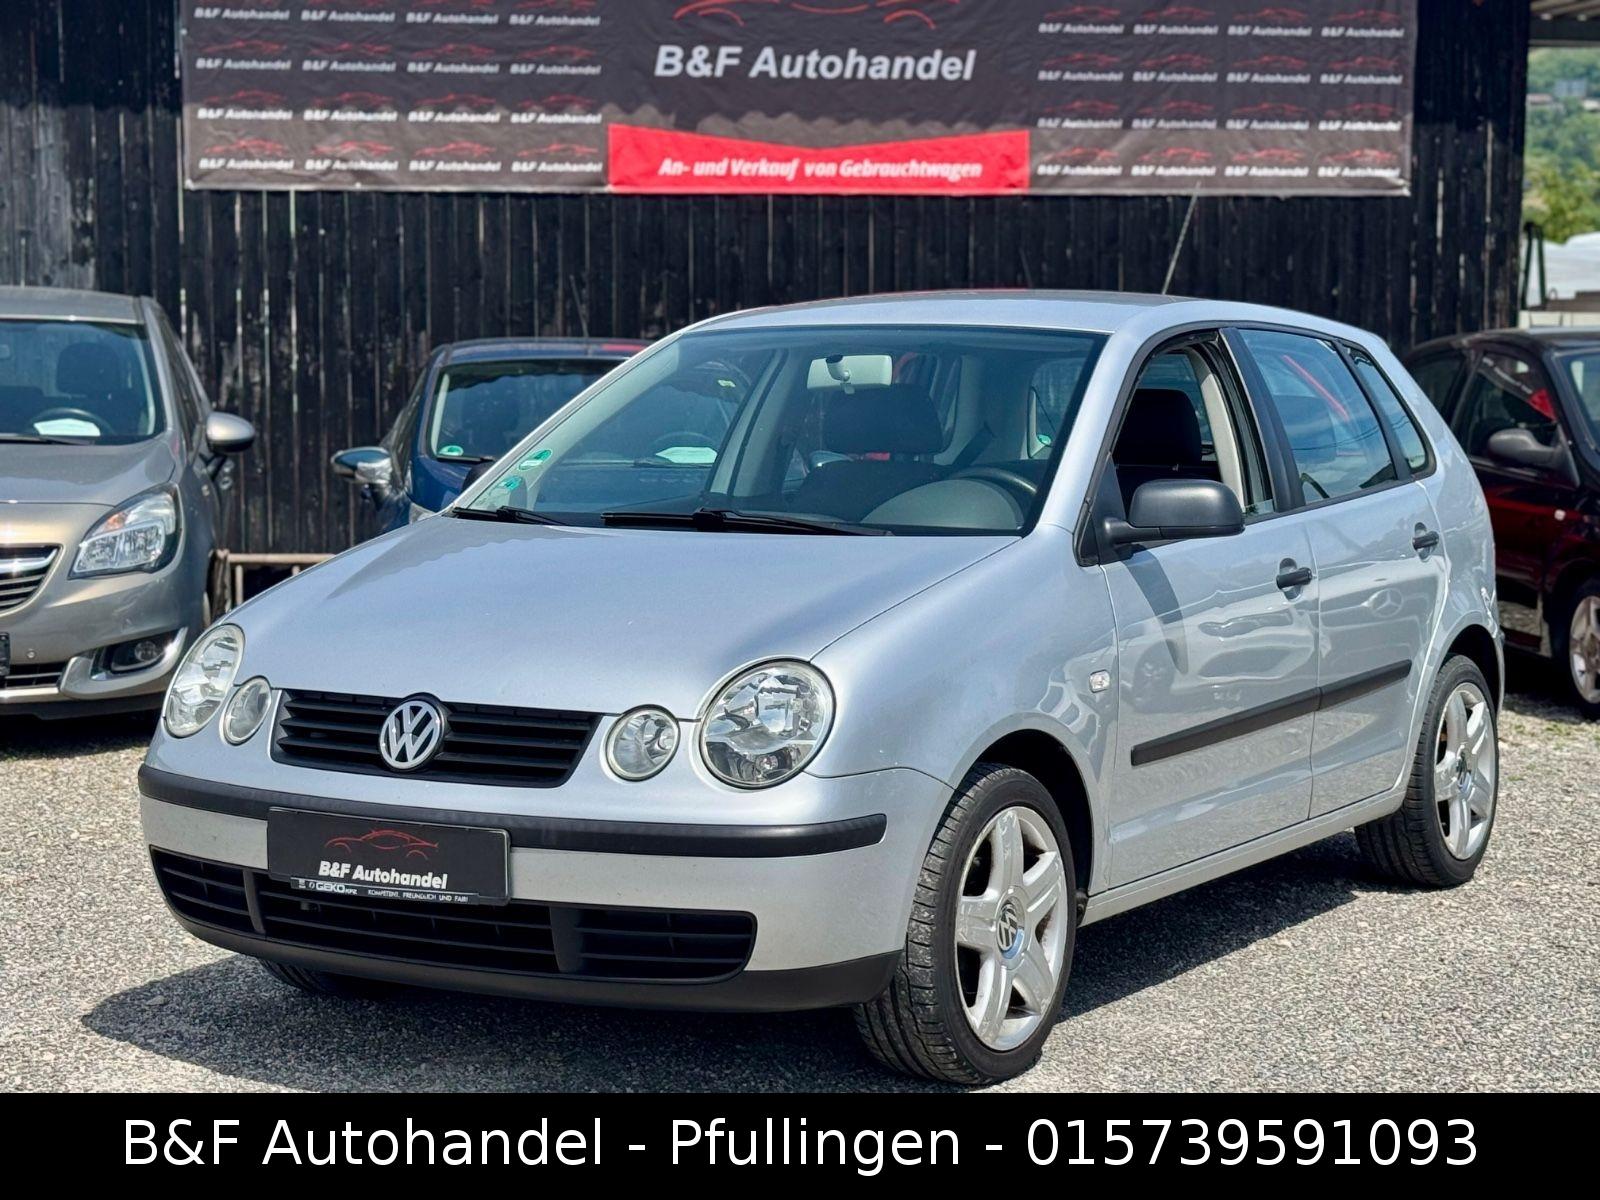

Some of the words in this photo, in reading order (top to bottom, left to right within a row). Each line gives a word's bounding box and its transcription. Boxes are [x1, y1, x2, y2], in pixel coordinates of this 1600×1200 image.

[655, 45, 742, 77] B&F
[749, 47, 976, 80] Autohandel
[658, 158, 690, 177] An-
[694, 158, 728, 177] und
[730, 158, 799, 181] Verkauf
[804, 162, 837, 177] von
[839, 160, 982, 181] Gebrauchtwagen
[318, 861, 350, 878] B&F
[352, 864, 448, 889] Autohandel
[316, 883, 346, 893] GEKO
